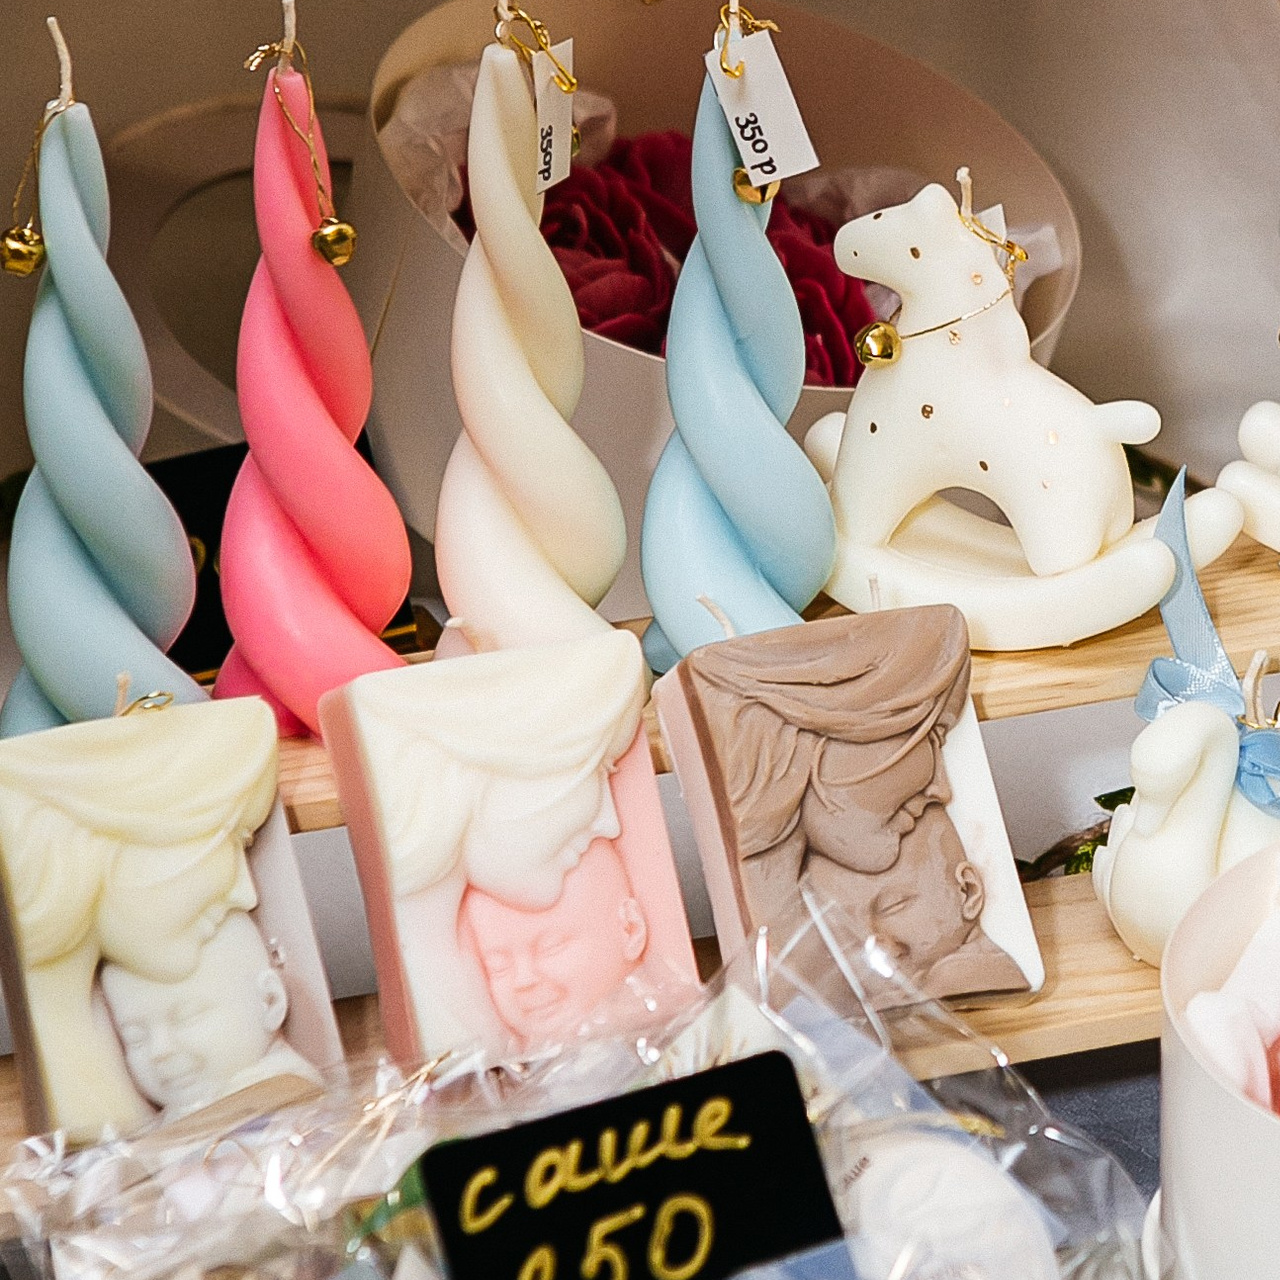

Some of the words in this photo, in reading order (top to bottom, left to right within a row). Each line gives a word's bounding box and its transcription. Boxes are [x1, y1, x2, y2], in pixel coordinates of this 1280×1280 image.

[735, 112, 769, 154] 350
[750, 156, 778, 175] р
[459, 1096, 752, 1236] саше
